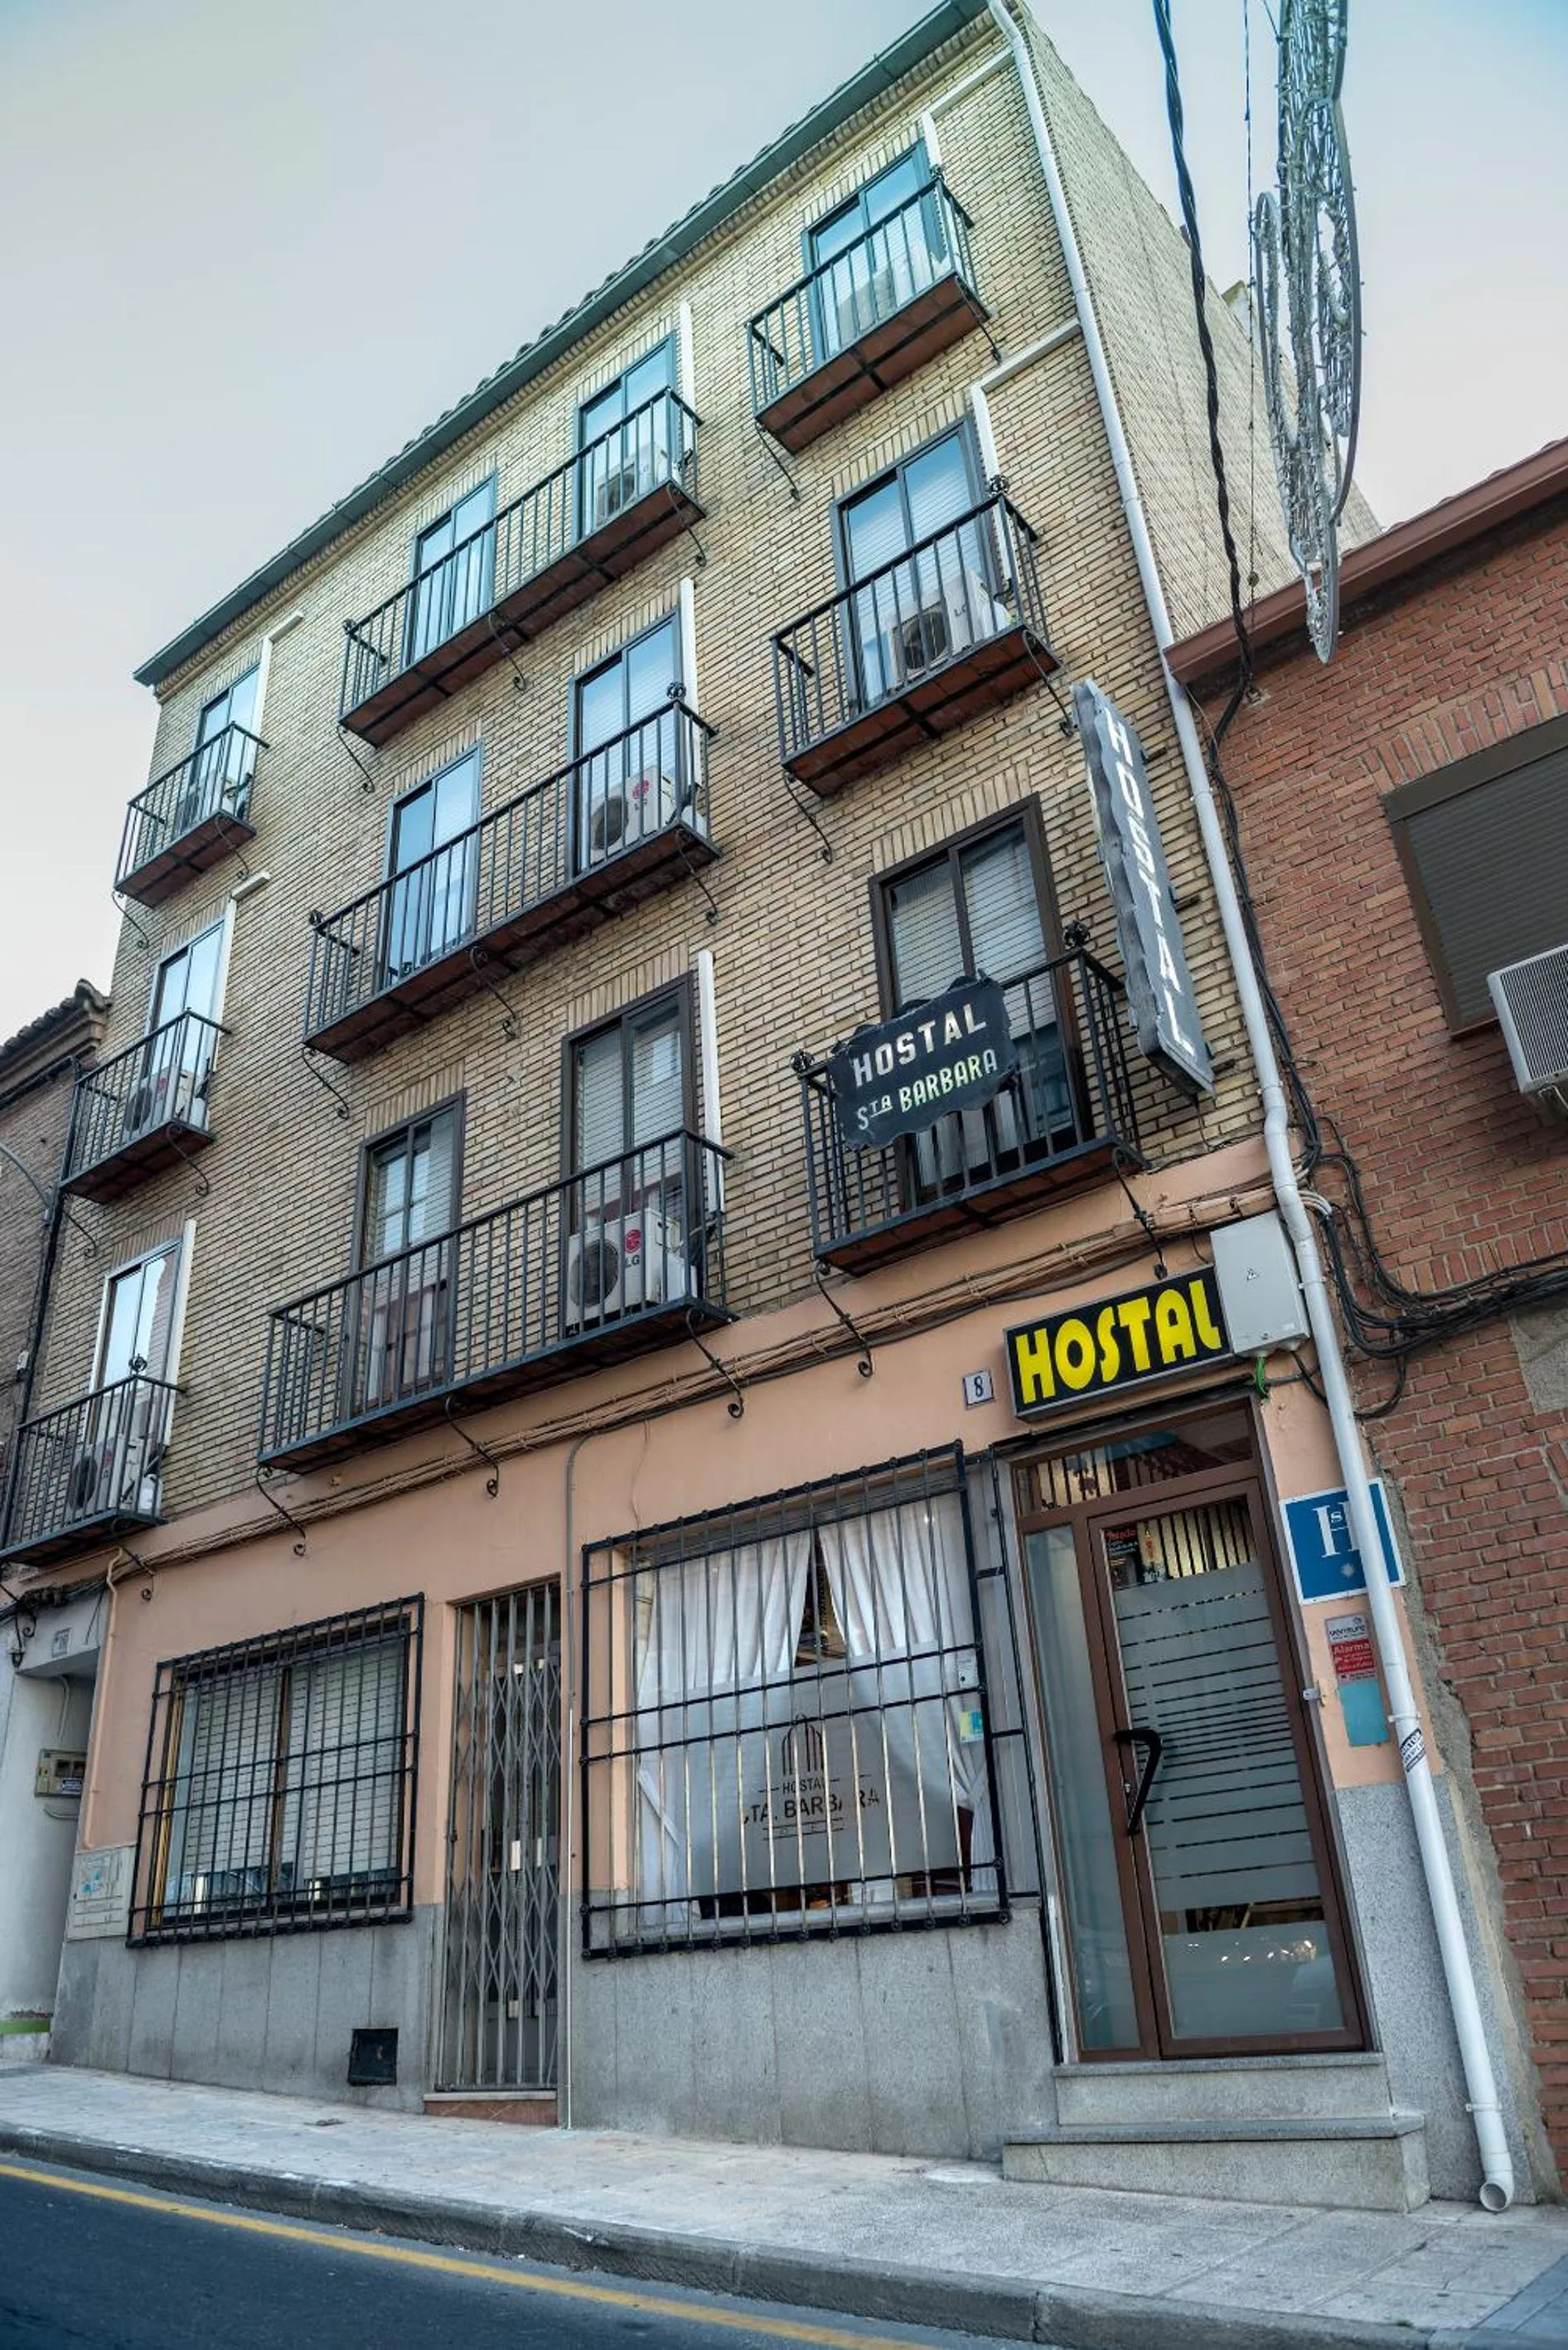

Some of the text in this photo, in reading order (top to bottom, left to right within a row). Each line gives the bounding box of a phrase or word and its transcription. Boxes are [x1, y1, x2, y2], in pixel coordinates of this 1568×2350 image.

[1105, 706, 1195, 1056] HOSTAL
[853, 1003, 987, 1088] HOSTAL
[898, 1049, 998, 1113] BARBARA
[1015, 1279, 1222, 1404] HOSTAL
[974, 1375, 984, 1398] 8
[743, 1801, 778, 1824] TA.
